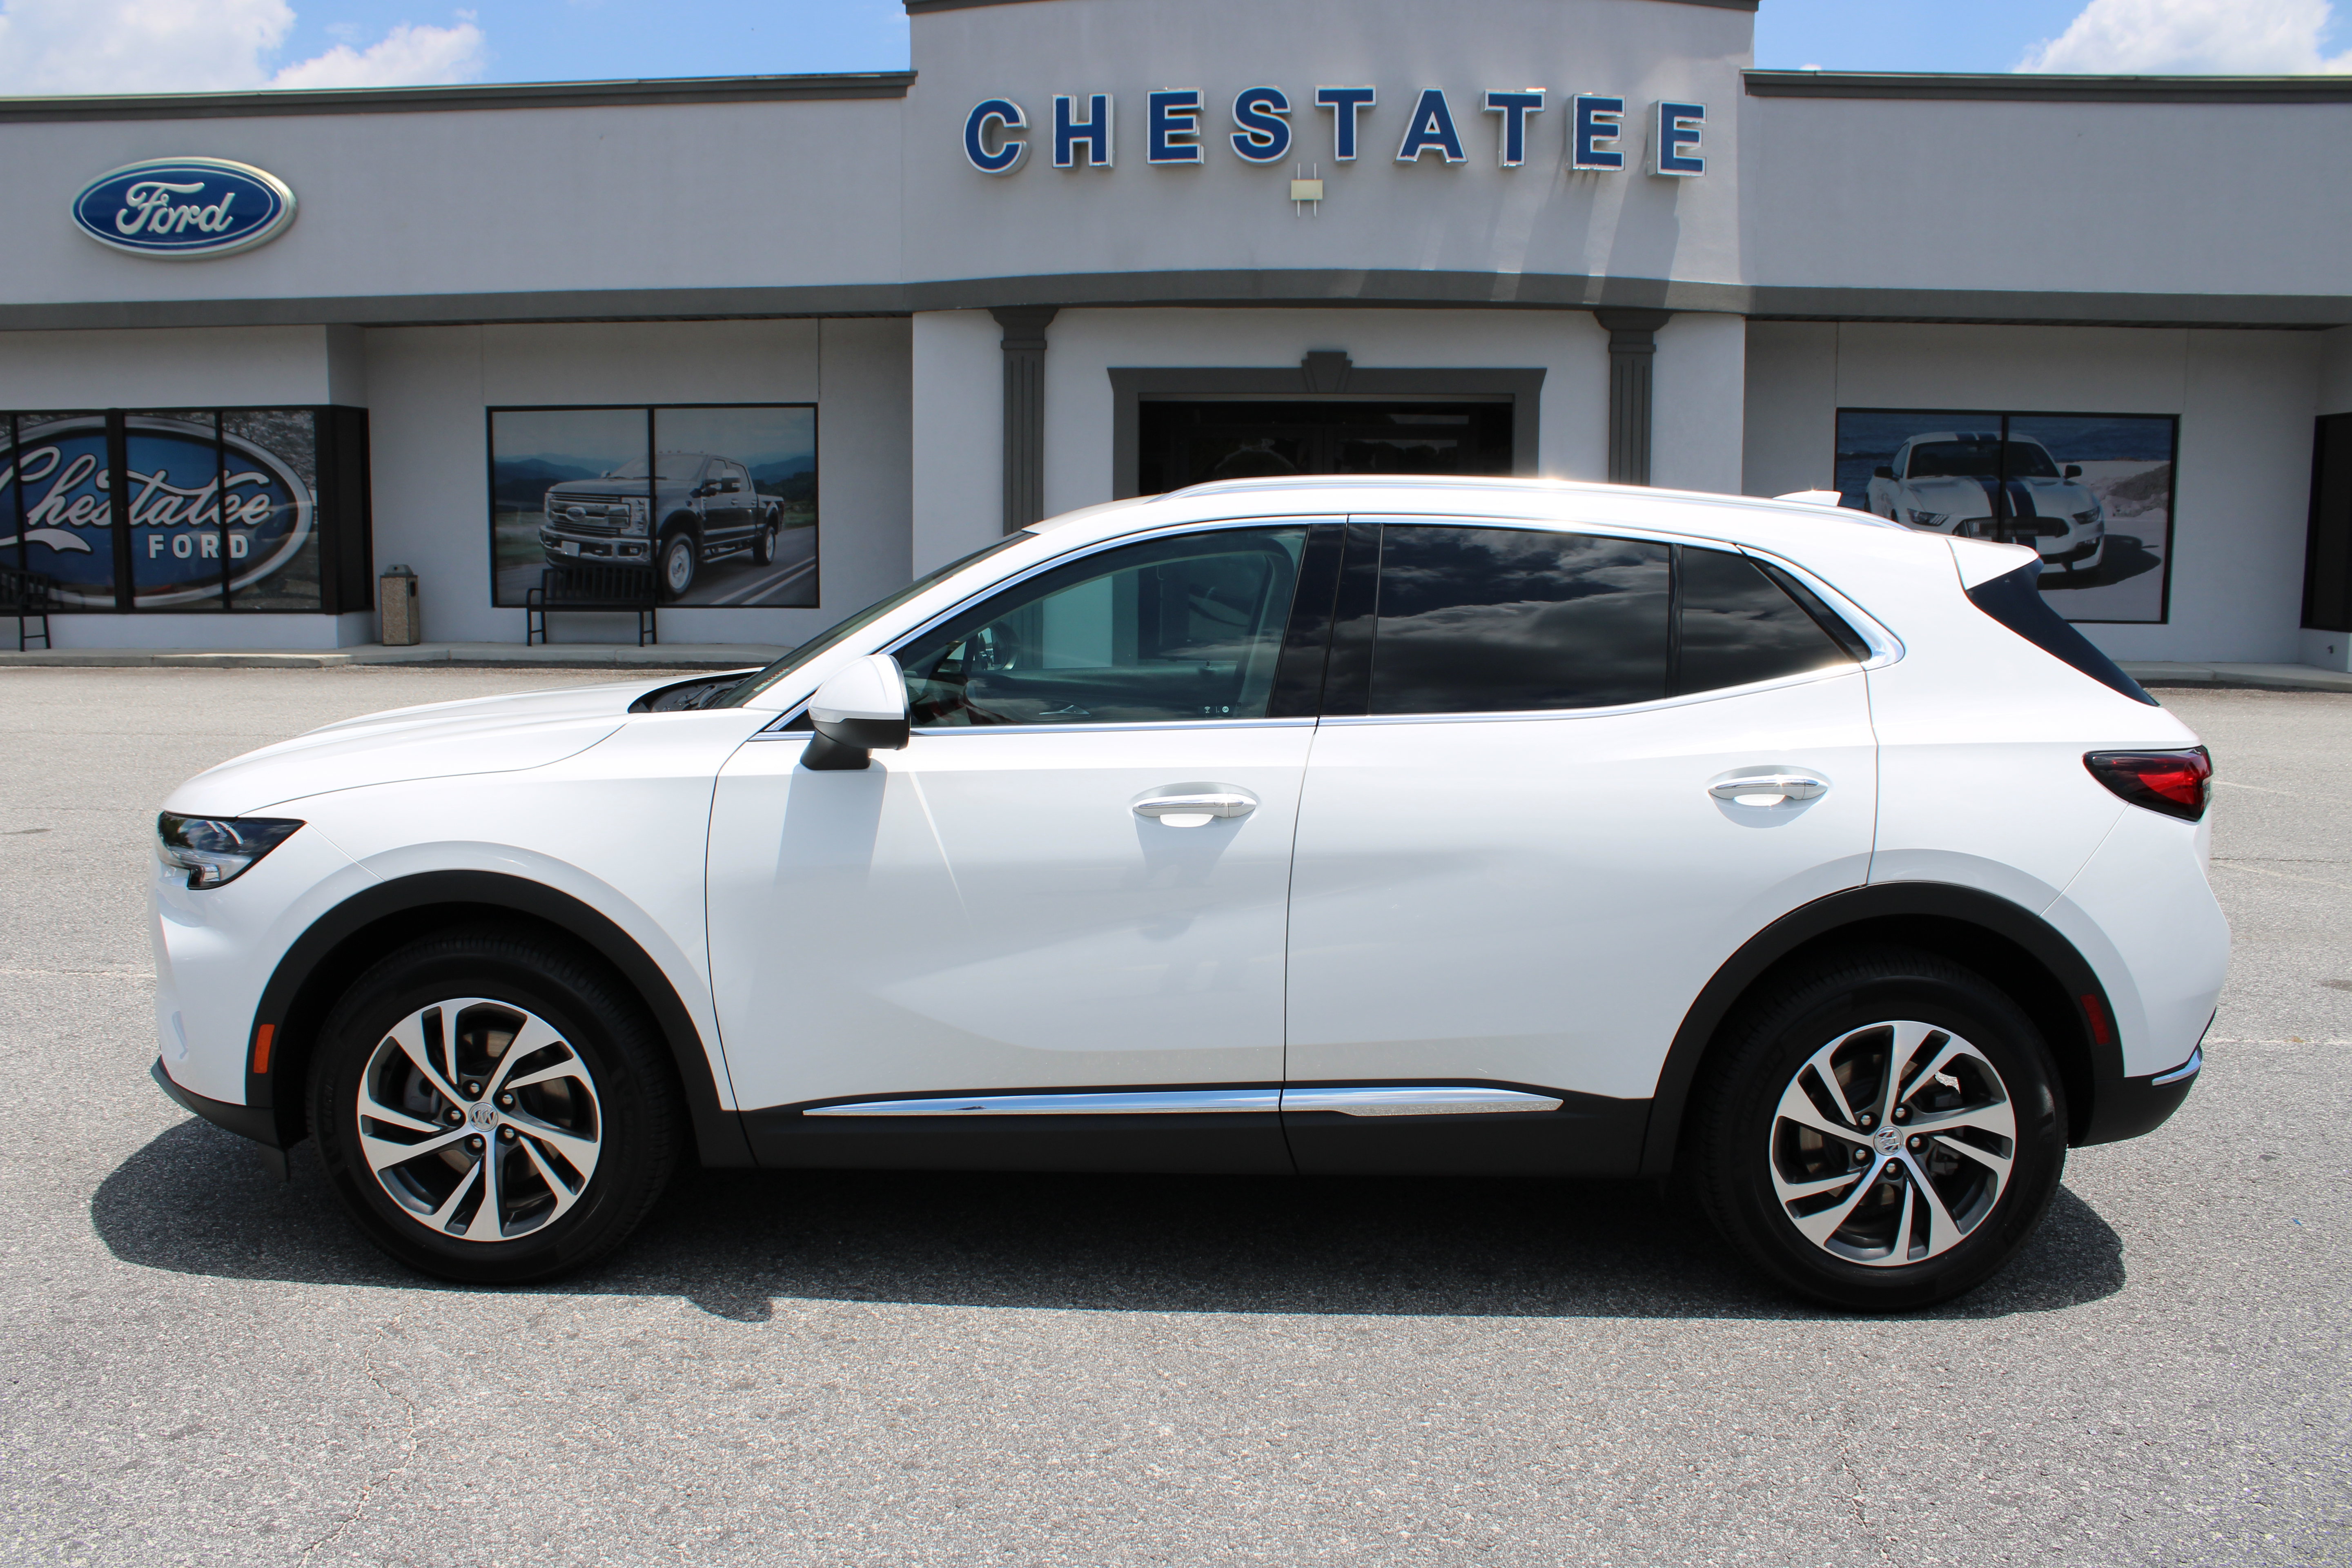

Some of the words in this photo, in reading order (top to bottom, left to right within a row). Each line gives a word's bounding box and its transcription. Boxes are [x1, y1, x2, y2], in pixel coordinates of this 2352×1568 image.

[962, 84, 1708, 177] CHESTATEE
[115, 181, 234, 235] Ford
[149, 534, 249, 559] FORD
